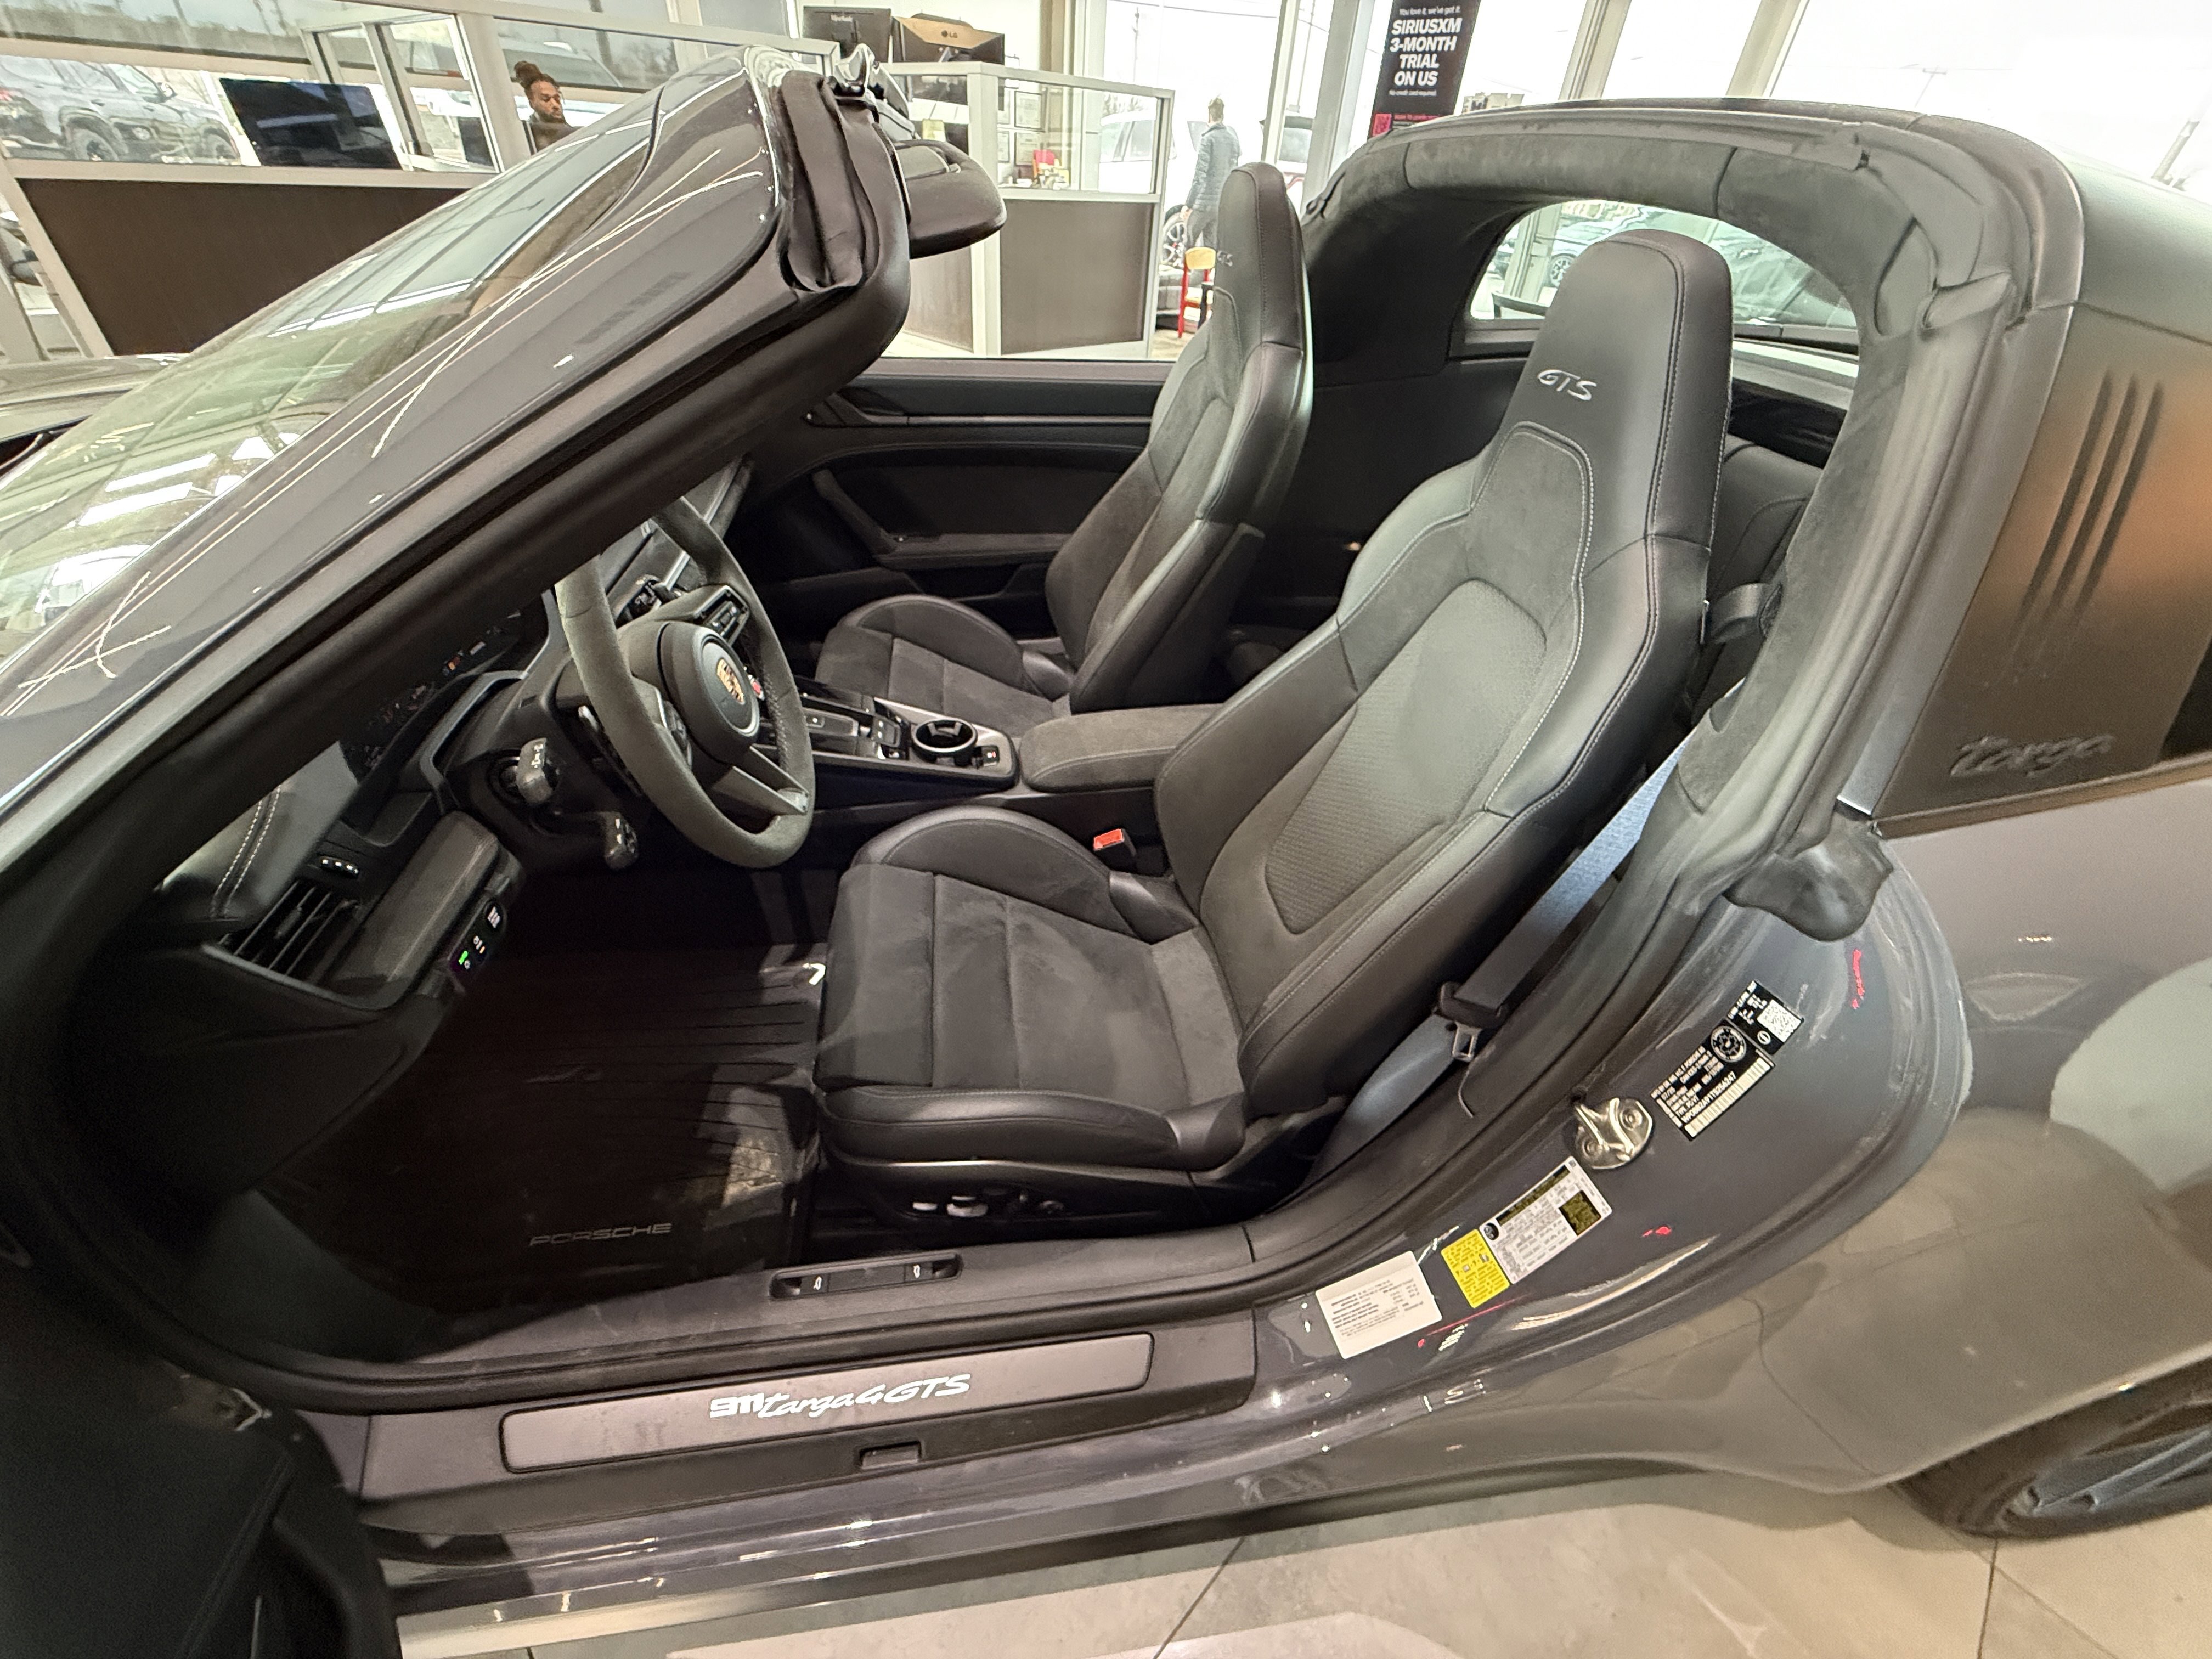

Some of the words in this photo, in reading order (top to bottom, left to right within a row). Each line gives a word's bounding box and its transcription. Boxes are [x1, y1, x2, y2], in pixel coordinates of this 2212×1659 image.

[1391, 17, 1463, 35] SIRIUSXM
[1390, 35, 1457, 53] 3-MONTH
[1399, 53, 1440, 69] TRIAL
[1394, 71, 1417, 86] ON
[1417, 71, 1438, 86] US
[1537, 369, 1598, 401] GTS
[529, 1222, 673, 1247] PORSCHE
[883, 1373, 971, 1403] GTS
